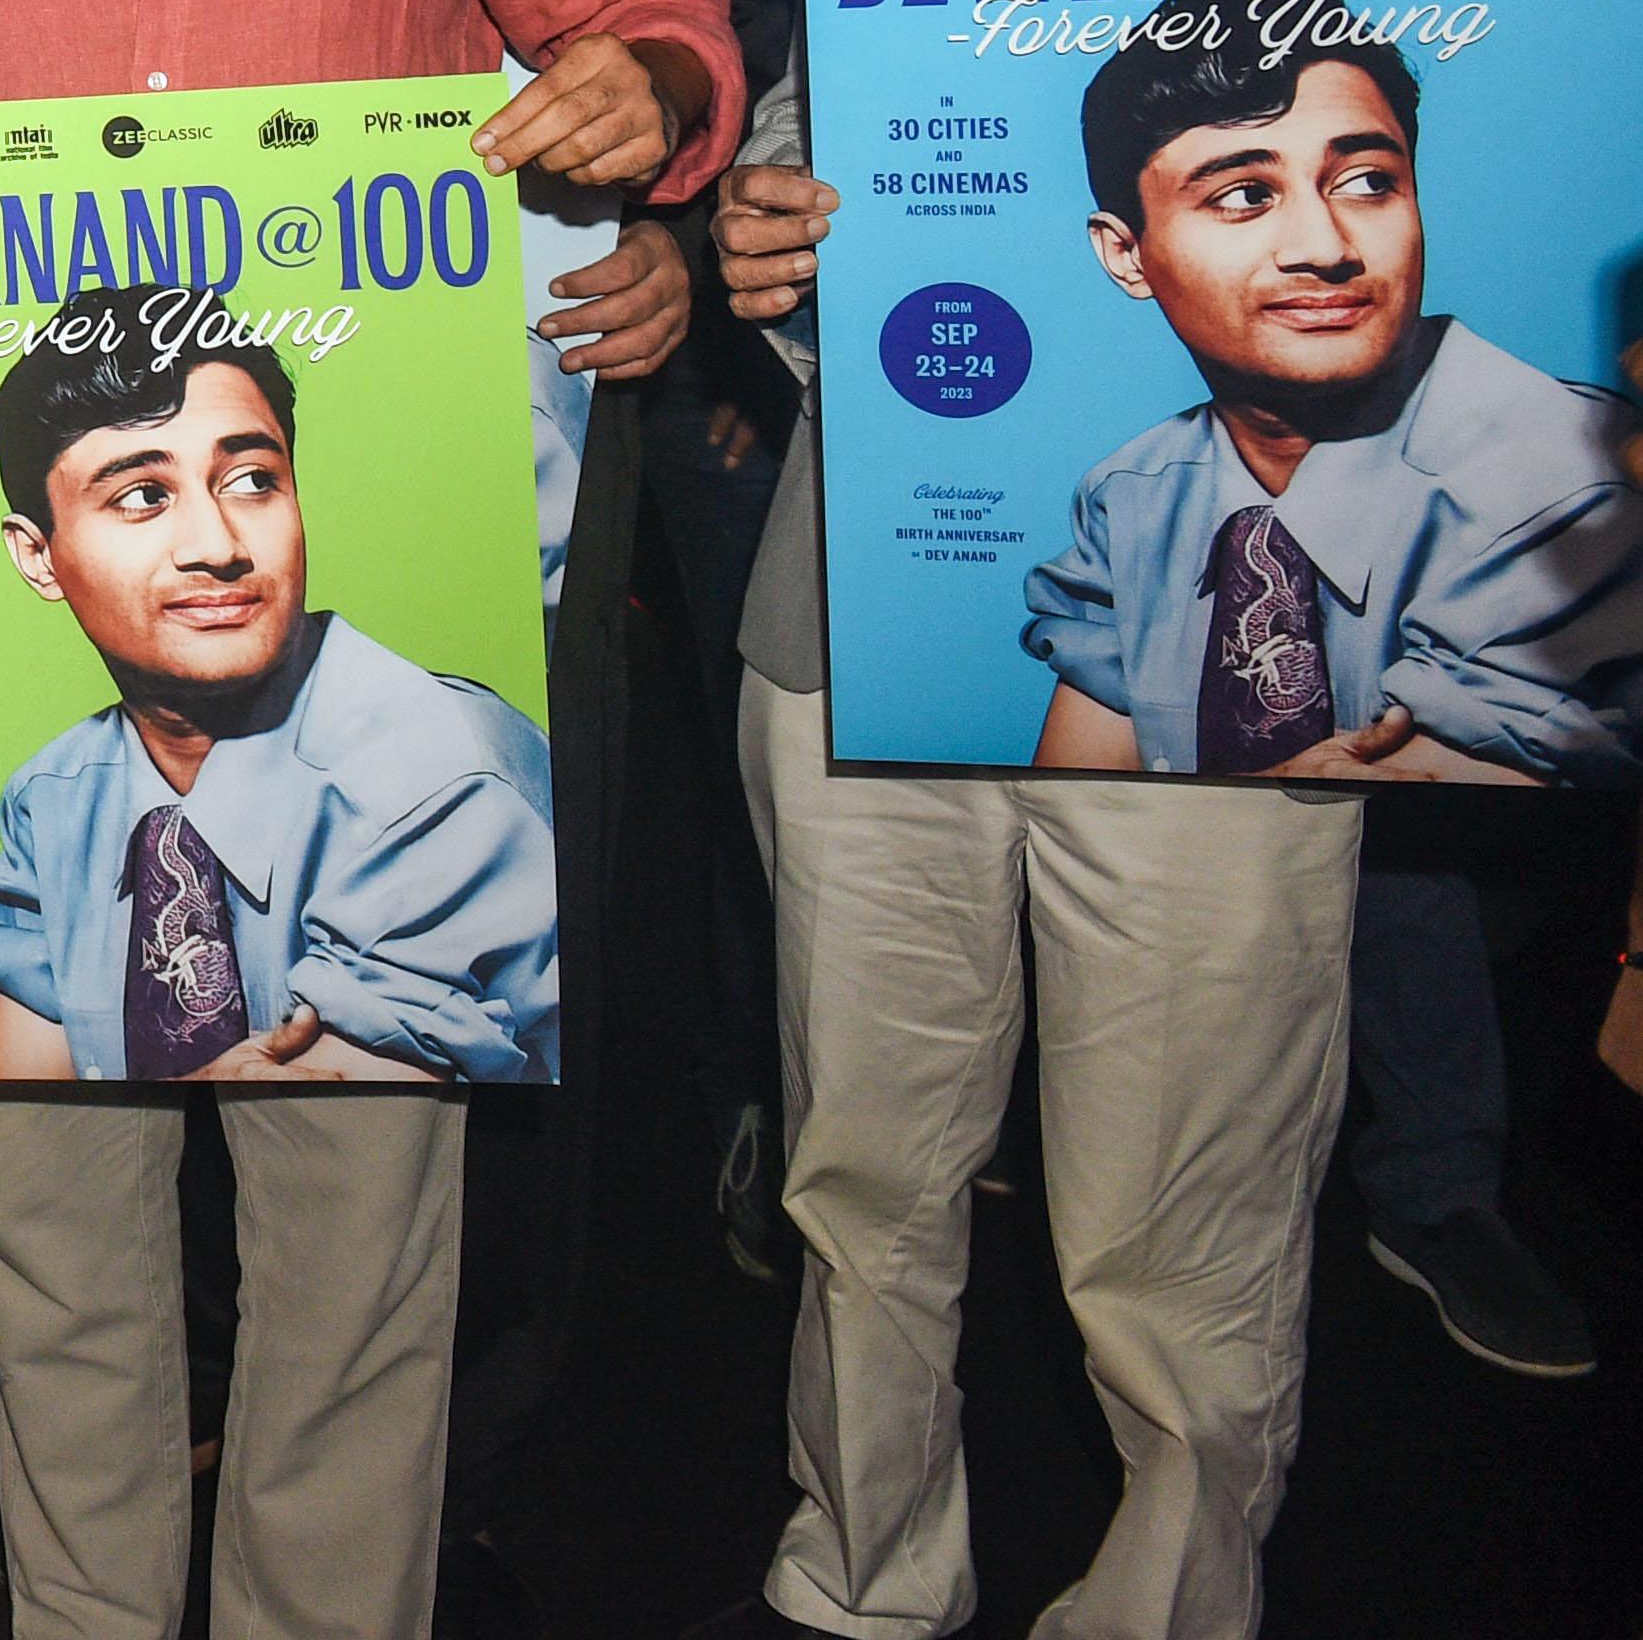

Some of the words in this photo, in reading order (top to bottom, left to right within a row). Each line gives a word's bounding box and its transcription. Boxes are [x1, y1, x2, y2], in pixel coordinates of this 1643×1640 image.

[888, 118, 919, 140] 30
[927, 117, 1009, 140] CITIES
[936, 150, 962, 162] AND
[872, 172, 903, 195] 58
[911, 171, 1028, 195] CINEMAS
[905, 204, 957, 216] ACROSS
[960, 204, 996, 216] INDIA
[257, 206, 321, 268] @
[335, 170, 488, 292] 100
[935, 301, 972, 314] FROM
[137, 288, 359, 372] Young
[931, 323, 978, 345] SEP
[940, 387, 973, 400] 2023
[896, 528, 933, 540] BIRTH
[936, 529, 1025, 543] ANNIVERSARY
